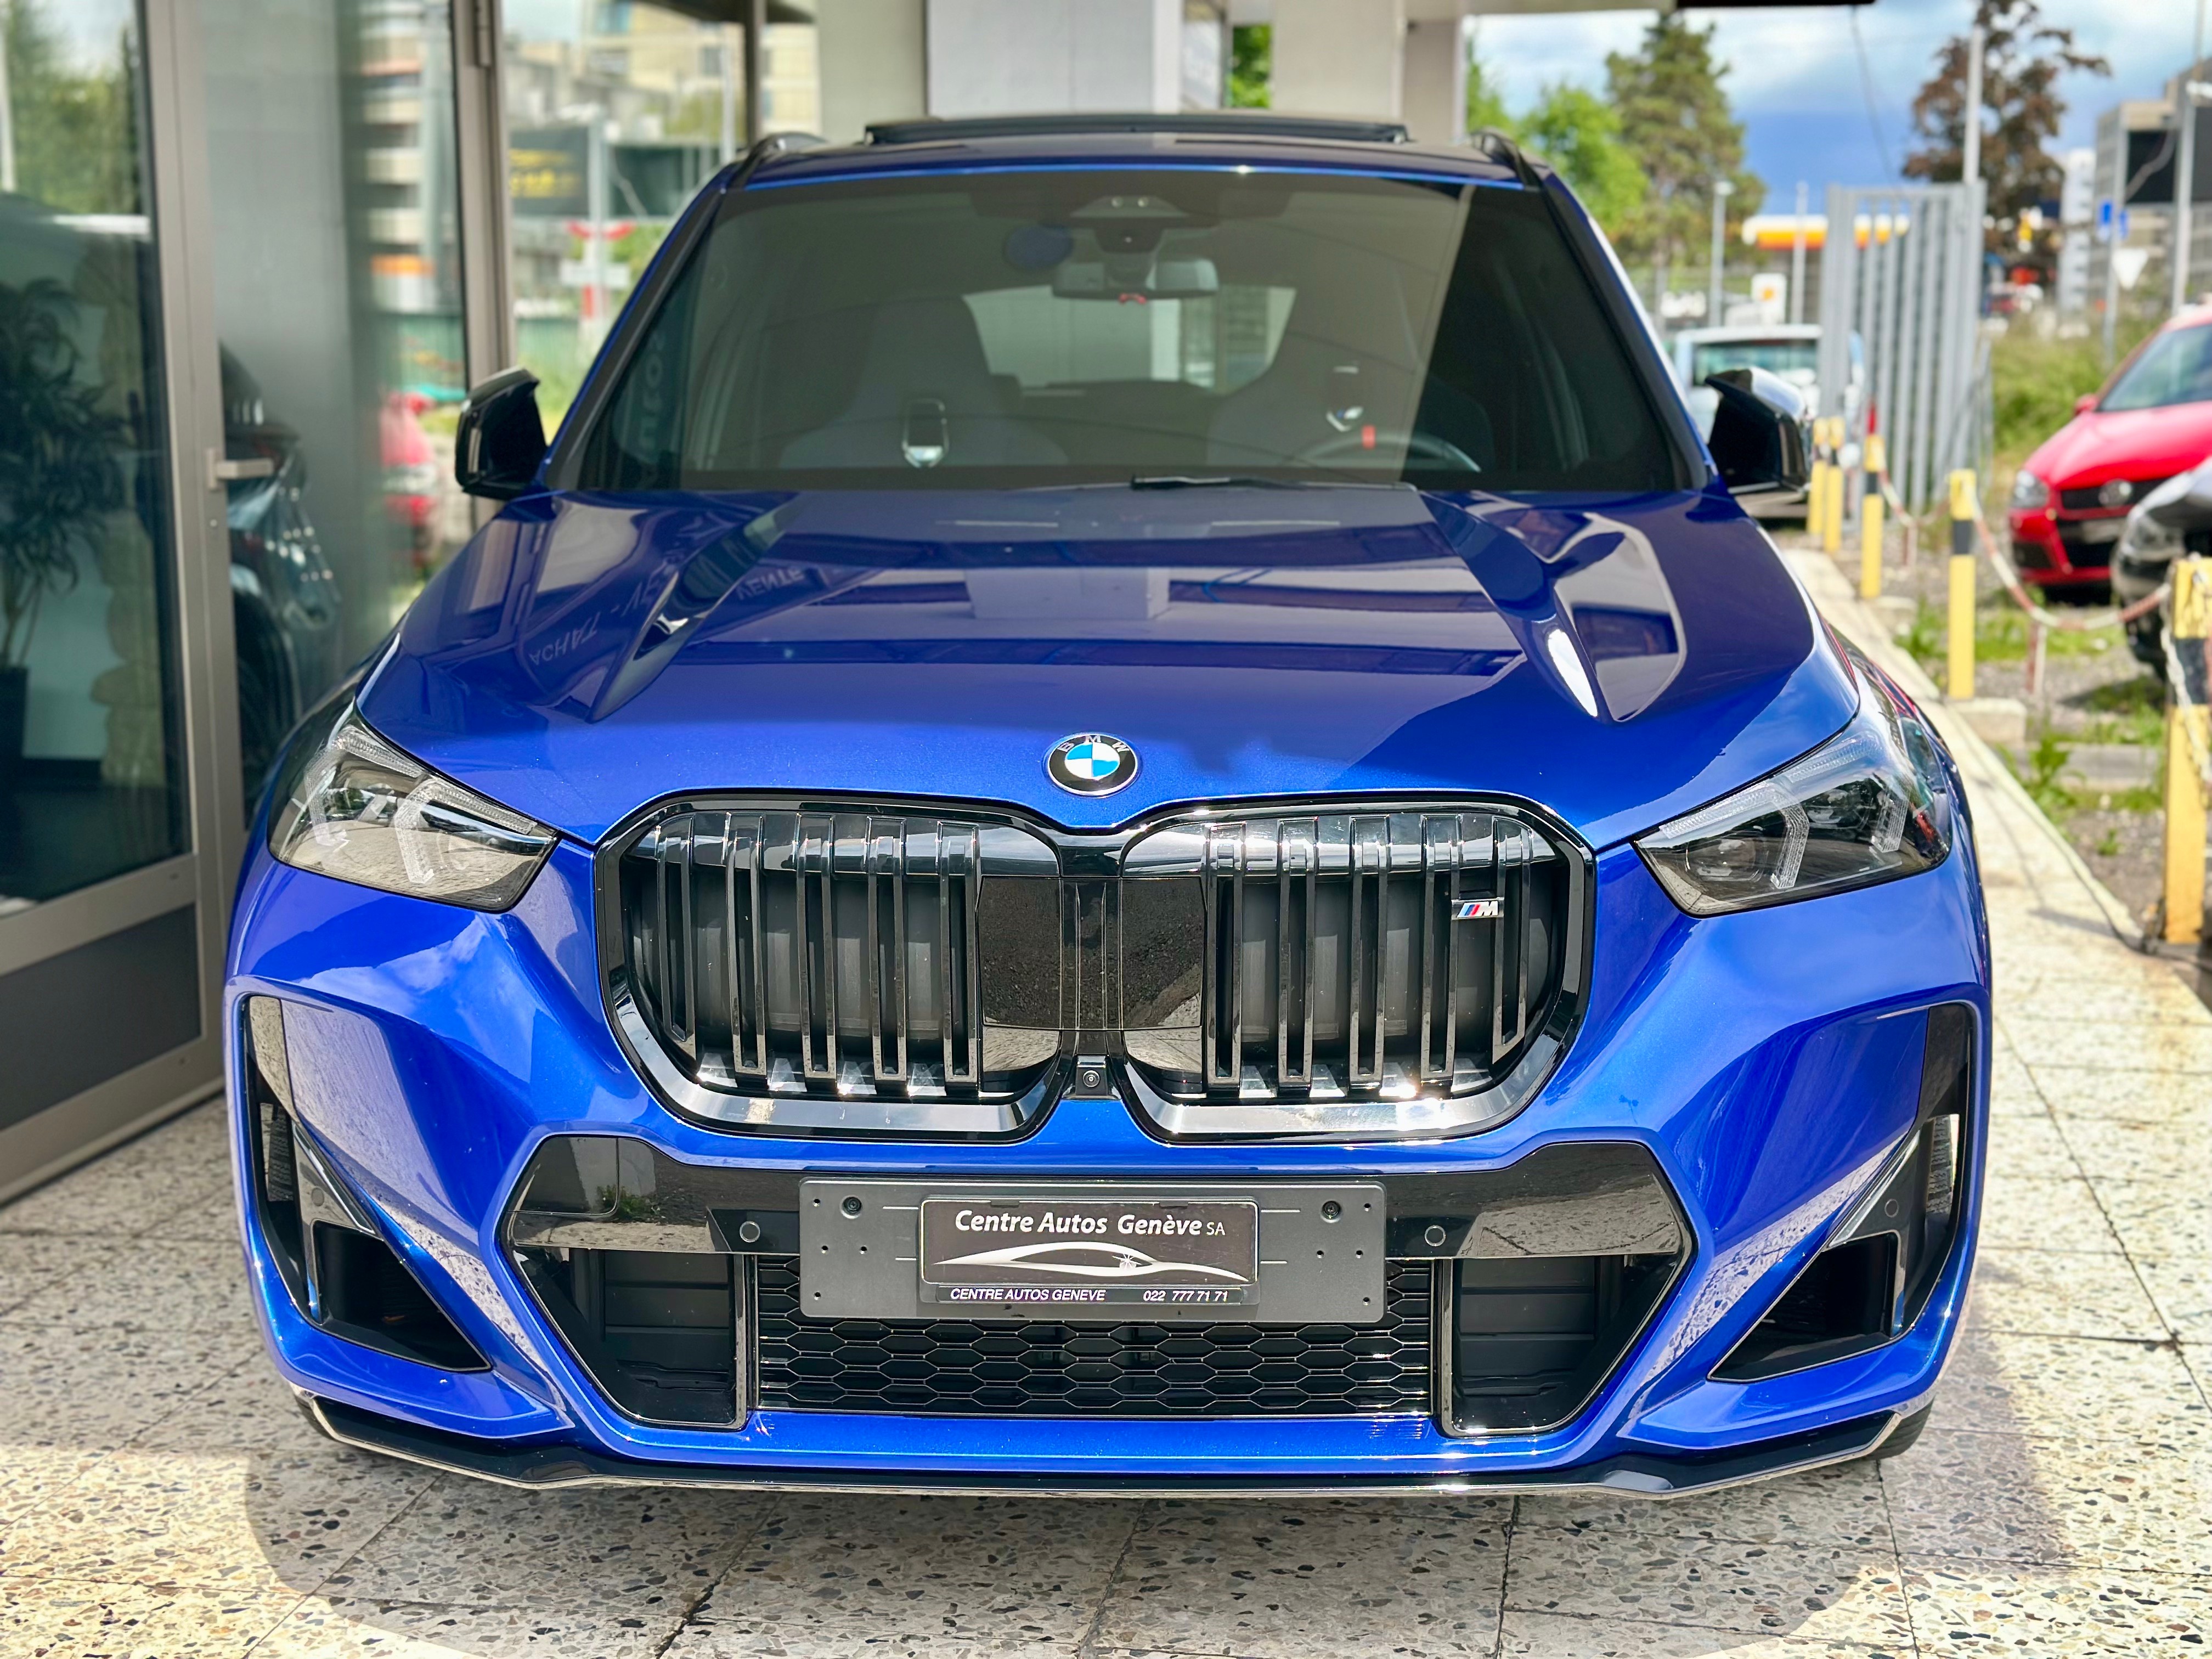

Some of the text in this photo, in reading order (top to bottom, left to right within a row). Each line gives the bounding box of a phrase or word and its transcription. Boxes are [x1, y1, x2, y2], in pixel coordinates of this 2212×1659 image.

[1057, 735, 1130, 753] BMW
[955, 1210, 1226, 1236] Centre Autos Genève SA
[950, 1288, 1228, 1301] CENTRE AUTOS GENEVE 022 777 71 71
